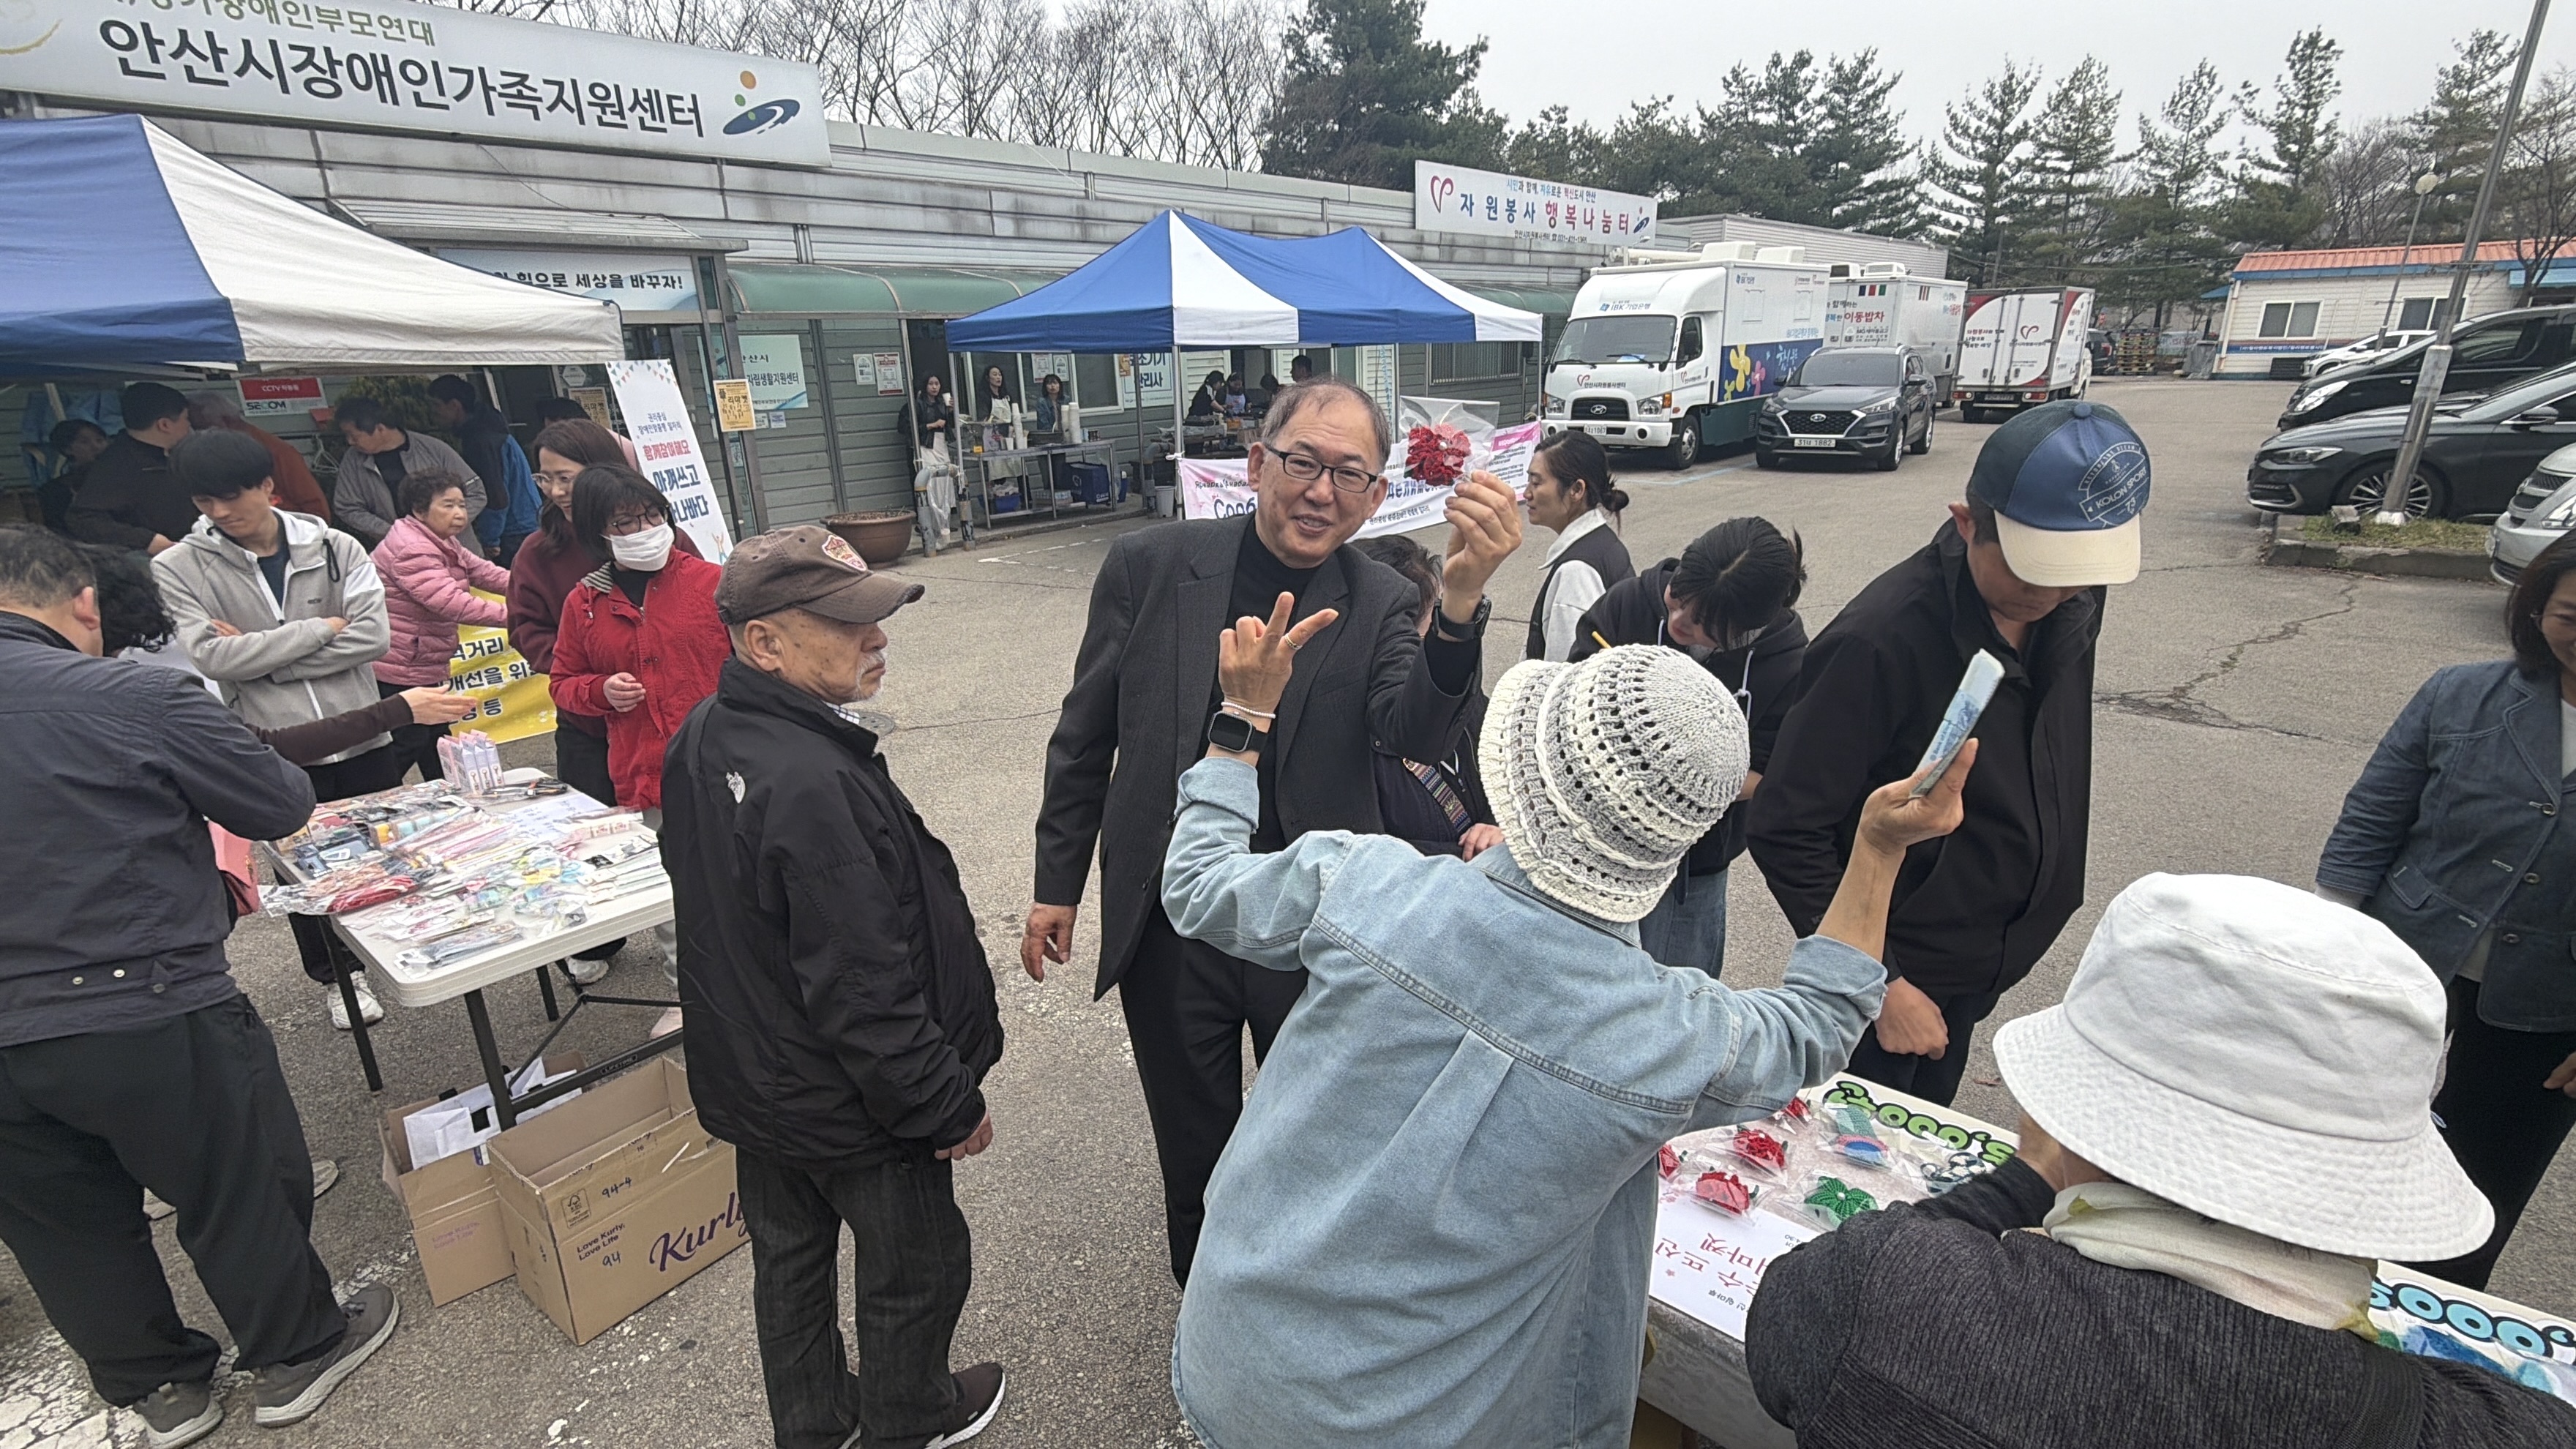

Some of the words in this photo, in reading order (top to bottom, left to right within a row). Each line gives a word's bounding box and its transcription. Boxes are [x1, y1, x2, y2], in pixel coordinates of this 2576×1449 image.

[100, 19, 705, 138] 안산시장애인가족지원센터
[576, 274, 624, 289] 세상을
[630, 275, 684, 290] 바꾸자!
[1844, 311, 1885, 323] 이동밥차
[746, 372, 800, 386] 자립생활지원센터
[246, 401, 287, 410] SECOM
[653, 464, 700, 493] 아껴쓰고
[2095, 486, 2128, 509] KOLON
[2127, 466, 2147, 489] SPORT
[483, 698, 503, 716] 등
[602, 1177, 632, 1198] 94-4
[577, 1238, 599, 1253] Love
[600, 1223, 625, 1239] Kurly,
[579, 1245, 601, 1261] Love
[602, 1235, 619, 1247] Life
[602, 1251, 621, 1267] 94
[1655, 1238, 1710, 1272] 뜨신
